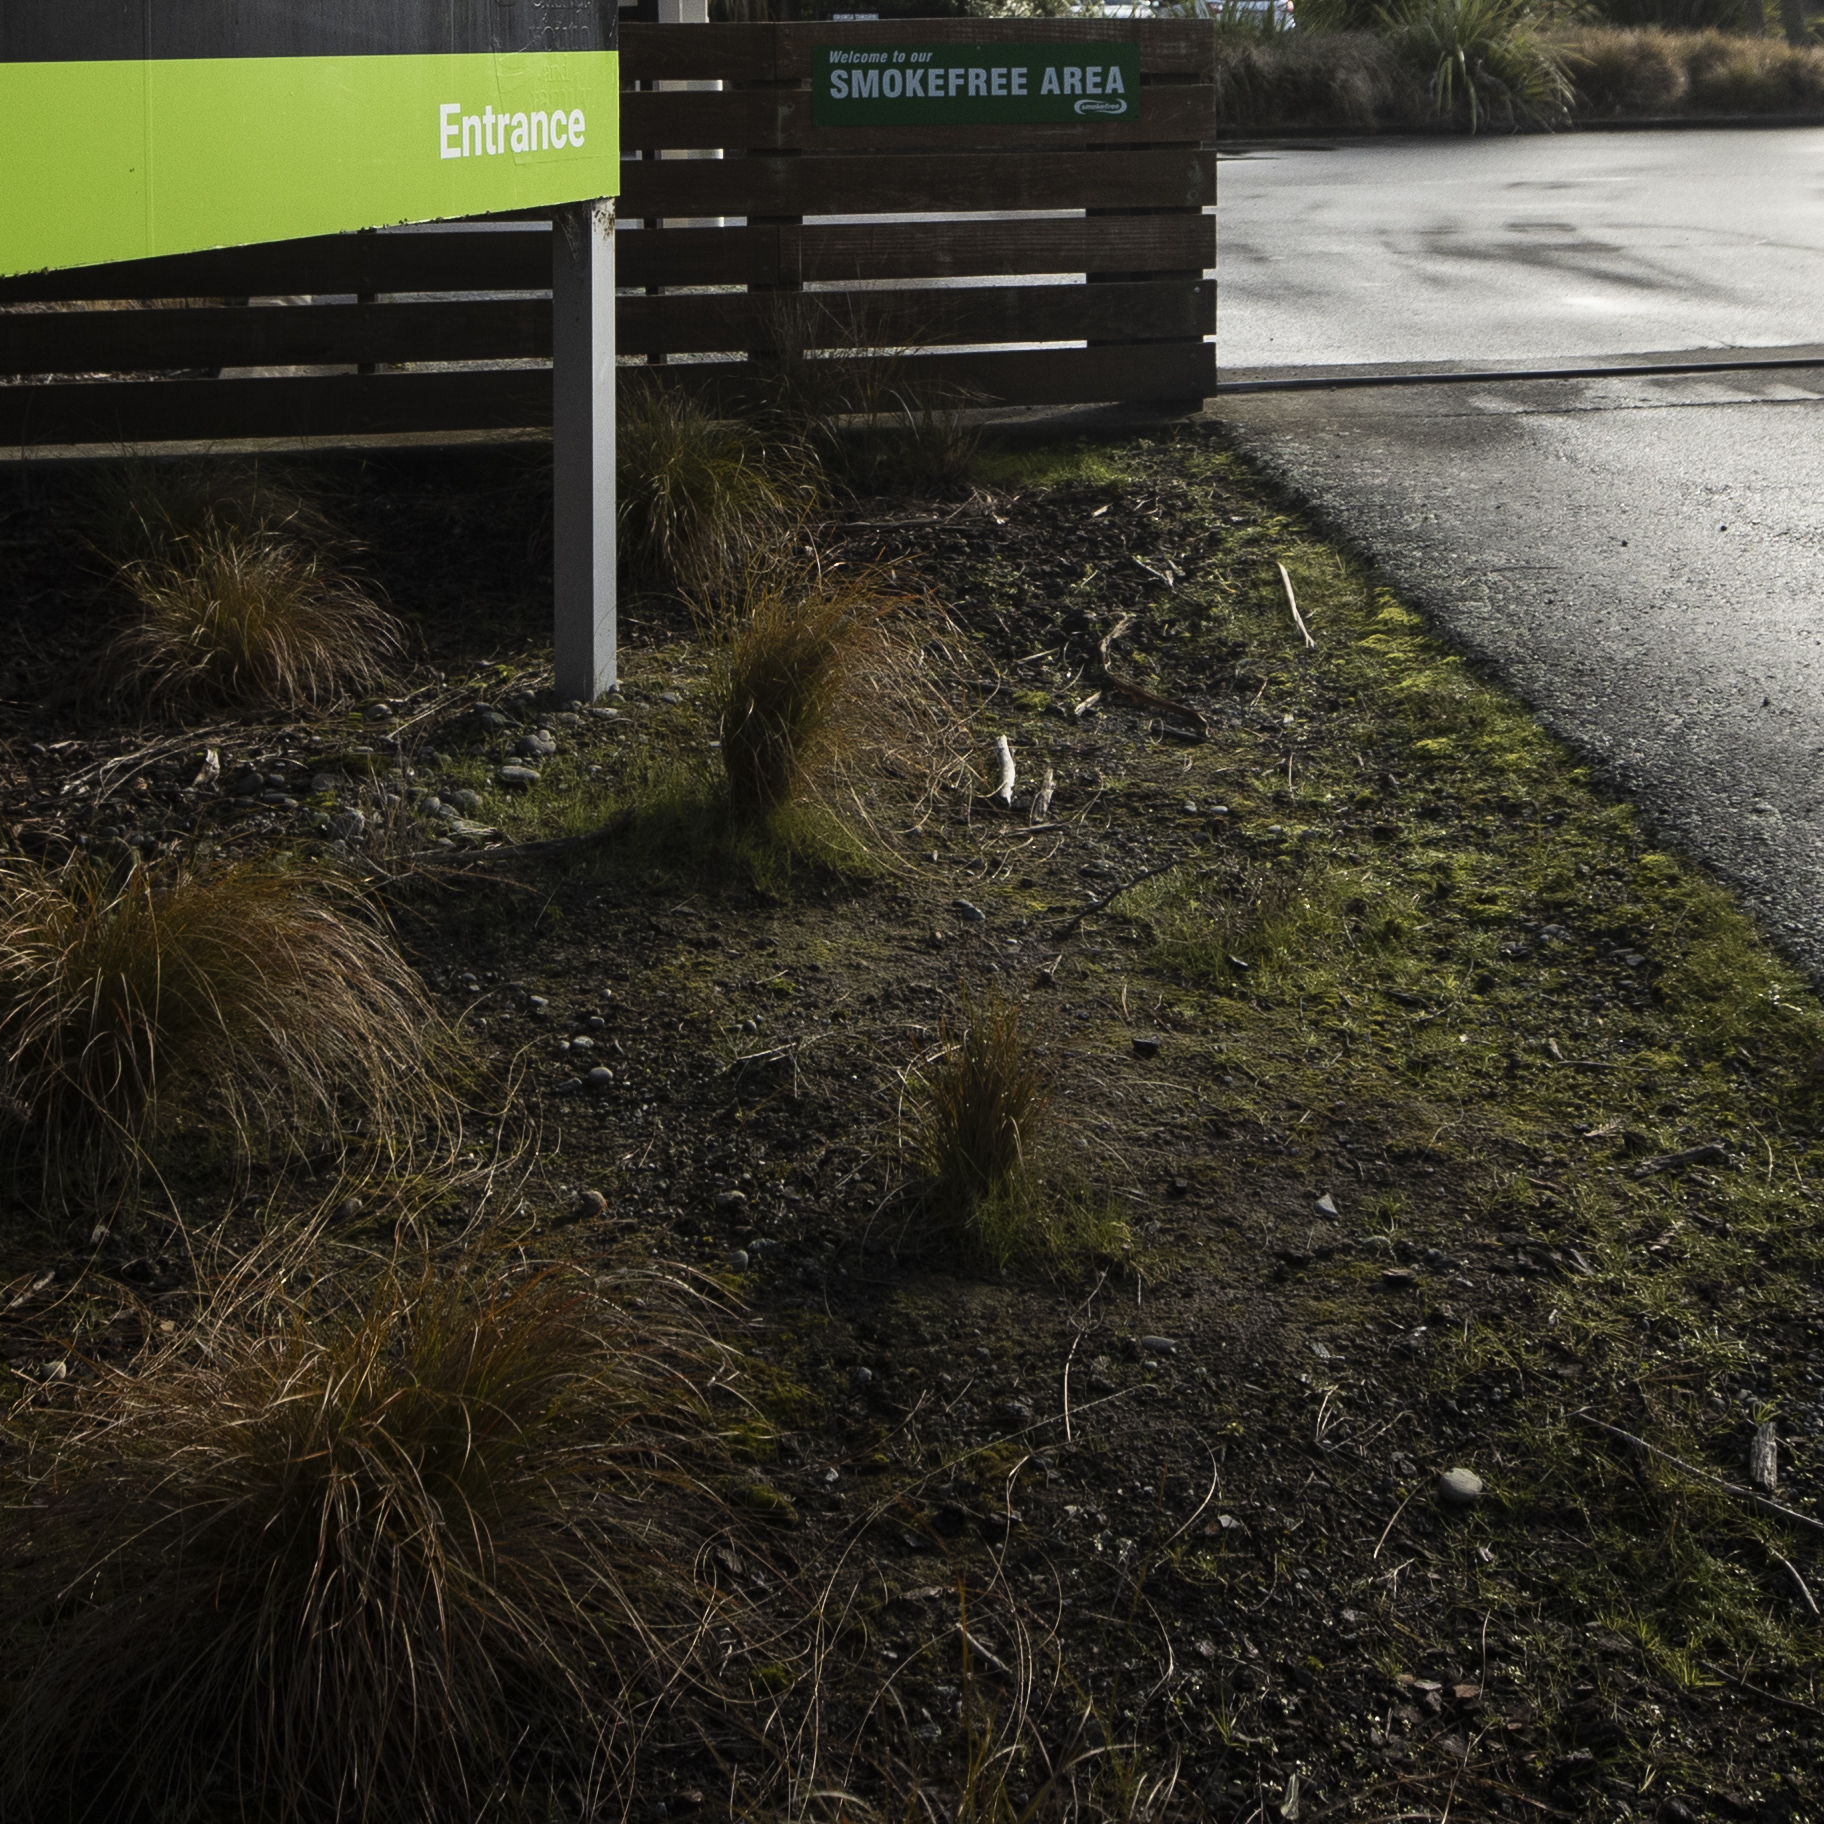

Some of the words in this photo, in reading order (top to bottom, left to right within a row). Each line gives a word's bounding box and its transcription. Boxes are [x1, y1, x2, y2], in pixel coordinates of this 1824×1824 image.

[829, 50, 888, 64] Welcome
[892, 50, 906, 64] to
[910, 52, 933, 63] our
[830, 67, 1028, 99] SMOKEFREE
[1040, 66, 1125, 95] AREA
[439, 102, 586, 160] Entrance
